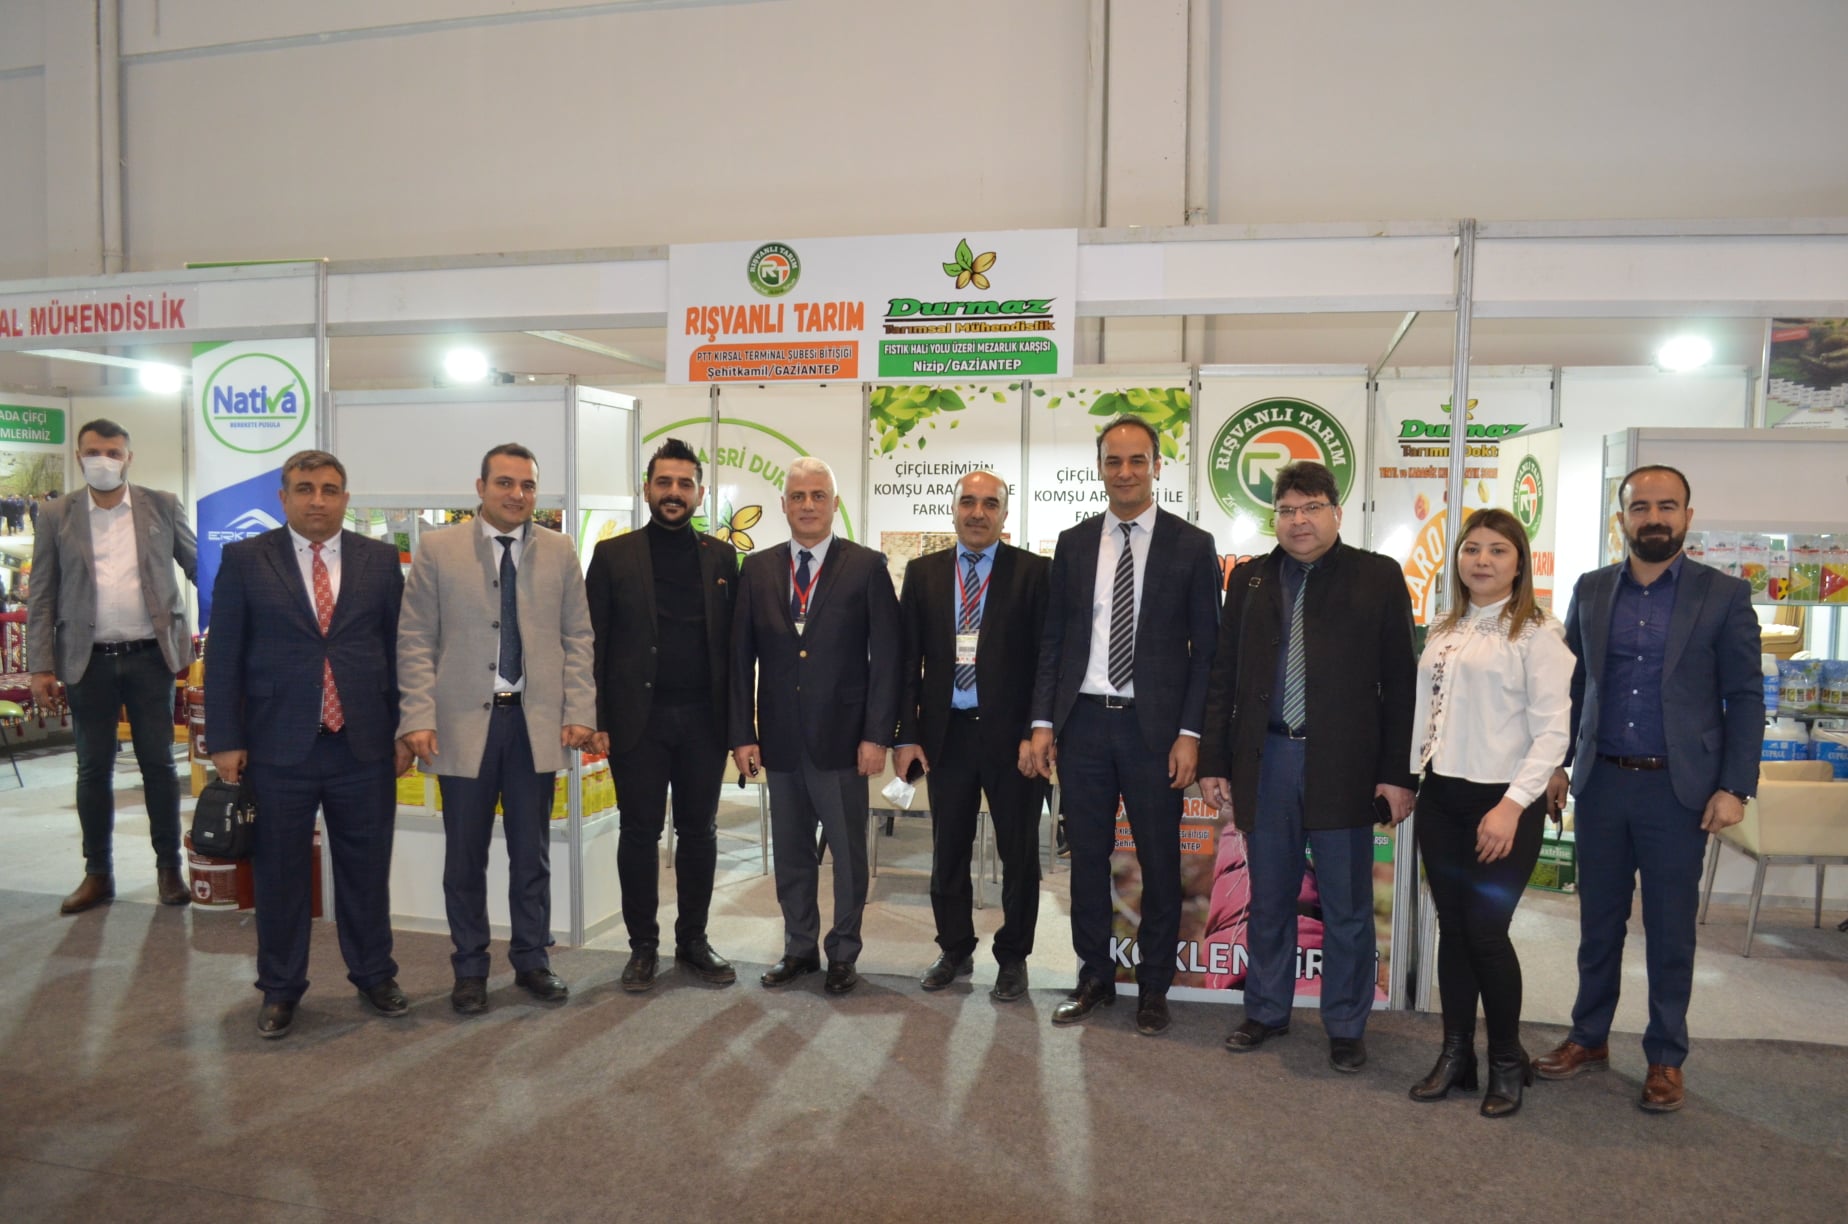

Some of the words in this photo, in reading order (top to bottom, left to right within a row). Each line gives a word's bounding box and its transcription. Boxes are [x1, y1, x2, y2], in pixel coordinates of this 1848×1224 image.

[30, 292, 186, 336] MÜHENDİSLİK
[883, 298, 1057, 317] Durmaz
[685, 303, 785, 343] RIŞVANLI
[793, 301, 865, 333] TARIM
[955, 320, 1056, 333] Mühendislik
[884, 344, 908, 355] FISTIK
[930, 343, 950, 354] YOLU
[952, 340, 976, 353] ÜZERİ
[978, 342, 1017, 353] MEZARLIK
[1019, 341, 1051, 355] KARŞISI
[697, 352, 713, 362] PTT
[714, 351, 742, 361] KIRSAL
[707, 362, 840, 380] Şehitkamil/GAZİANTEP
[913, 357, 1022, 374] Nizip/GAZİANTEP
[22, 409, 47, 425] ÇİFÇİ
[1397, 419, 1528, 439] Dumaz
[1216, 407, 1294, 471] RIŞVANLI
[1299, 411, 1347, 467] TARIM
[874, 484, 922, 497] KOMŞU
[1035, 490, 1085, 504] KOMŞU
[1164, 487, 1183, 503] İLE
[913, 504, 953, 515] FARKL
